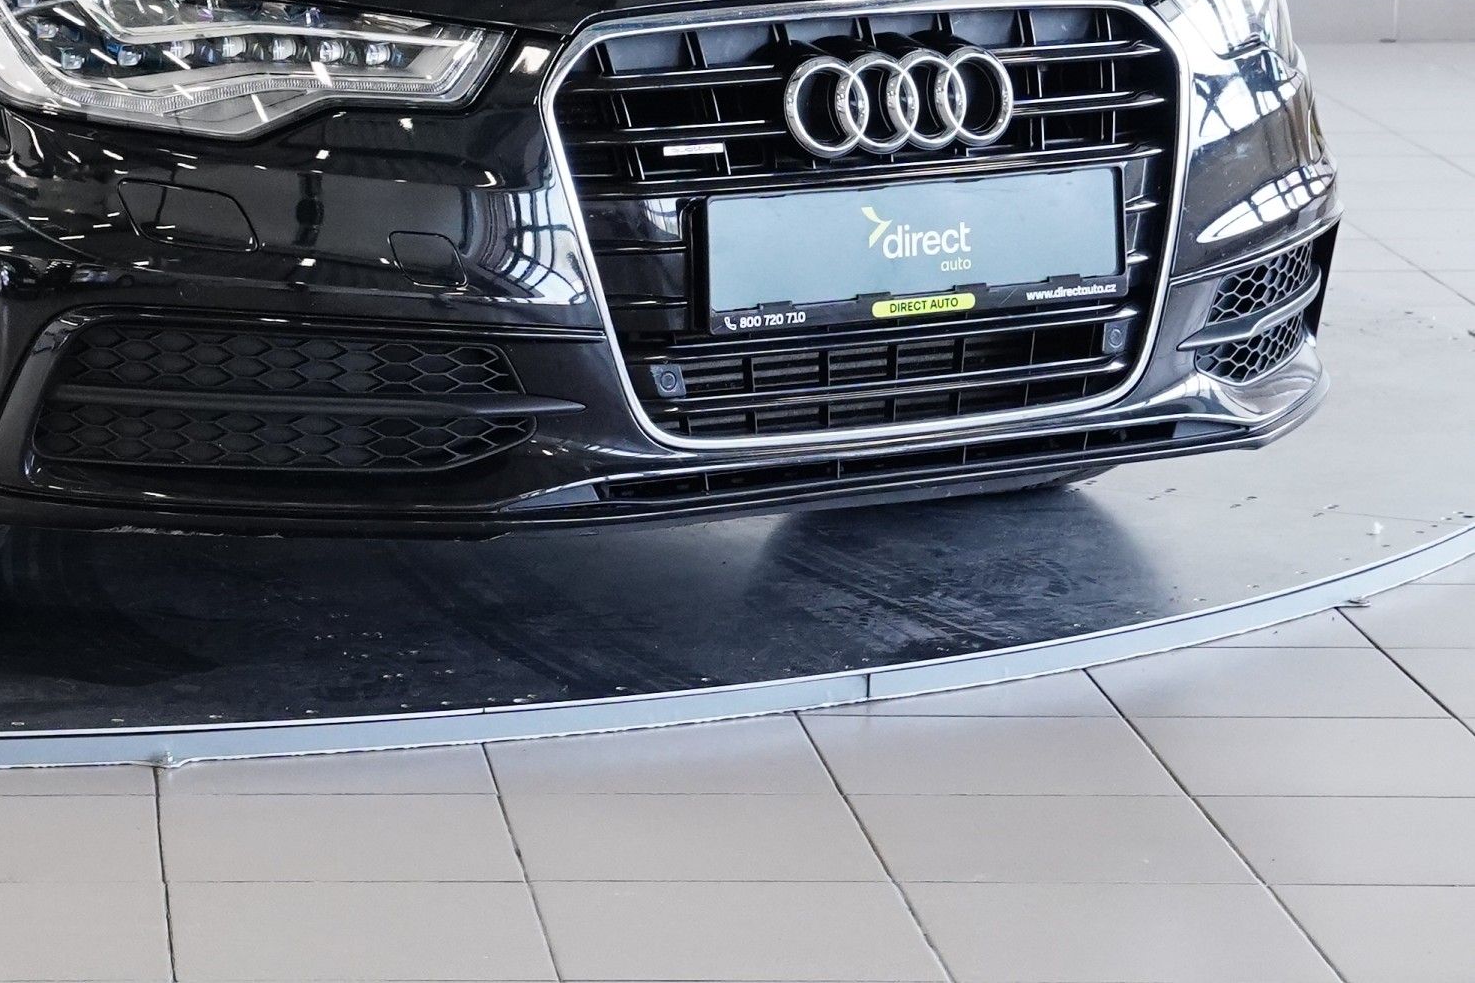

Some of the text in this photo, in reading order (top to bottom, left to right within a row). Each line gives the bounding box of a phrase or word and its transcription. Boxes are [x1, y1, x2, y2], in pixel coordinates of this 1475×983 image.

[882, 221, 971, 259] direct
[940, 256, 972, 272] auto
[1026, 283, 1117, 301] www.directauto.cz
[889, 297, 959, 314] DIRECT AUTO
[739, 311, 806, 328] 800 720 710
